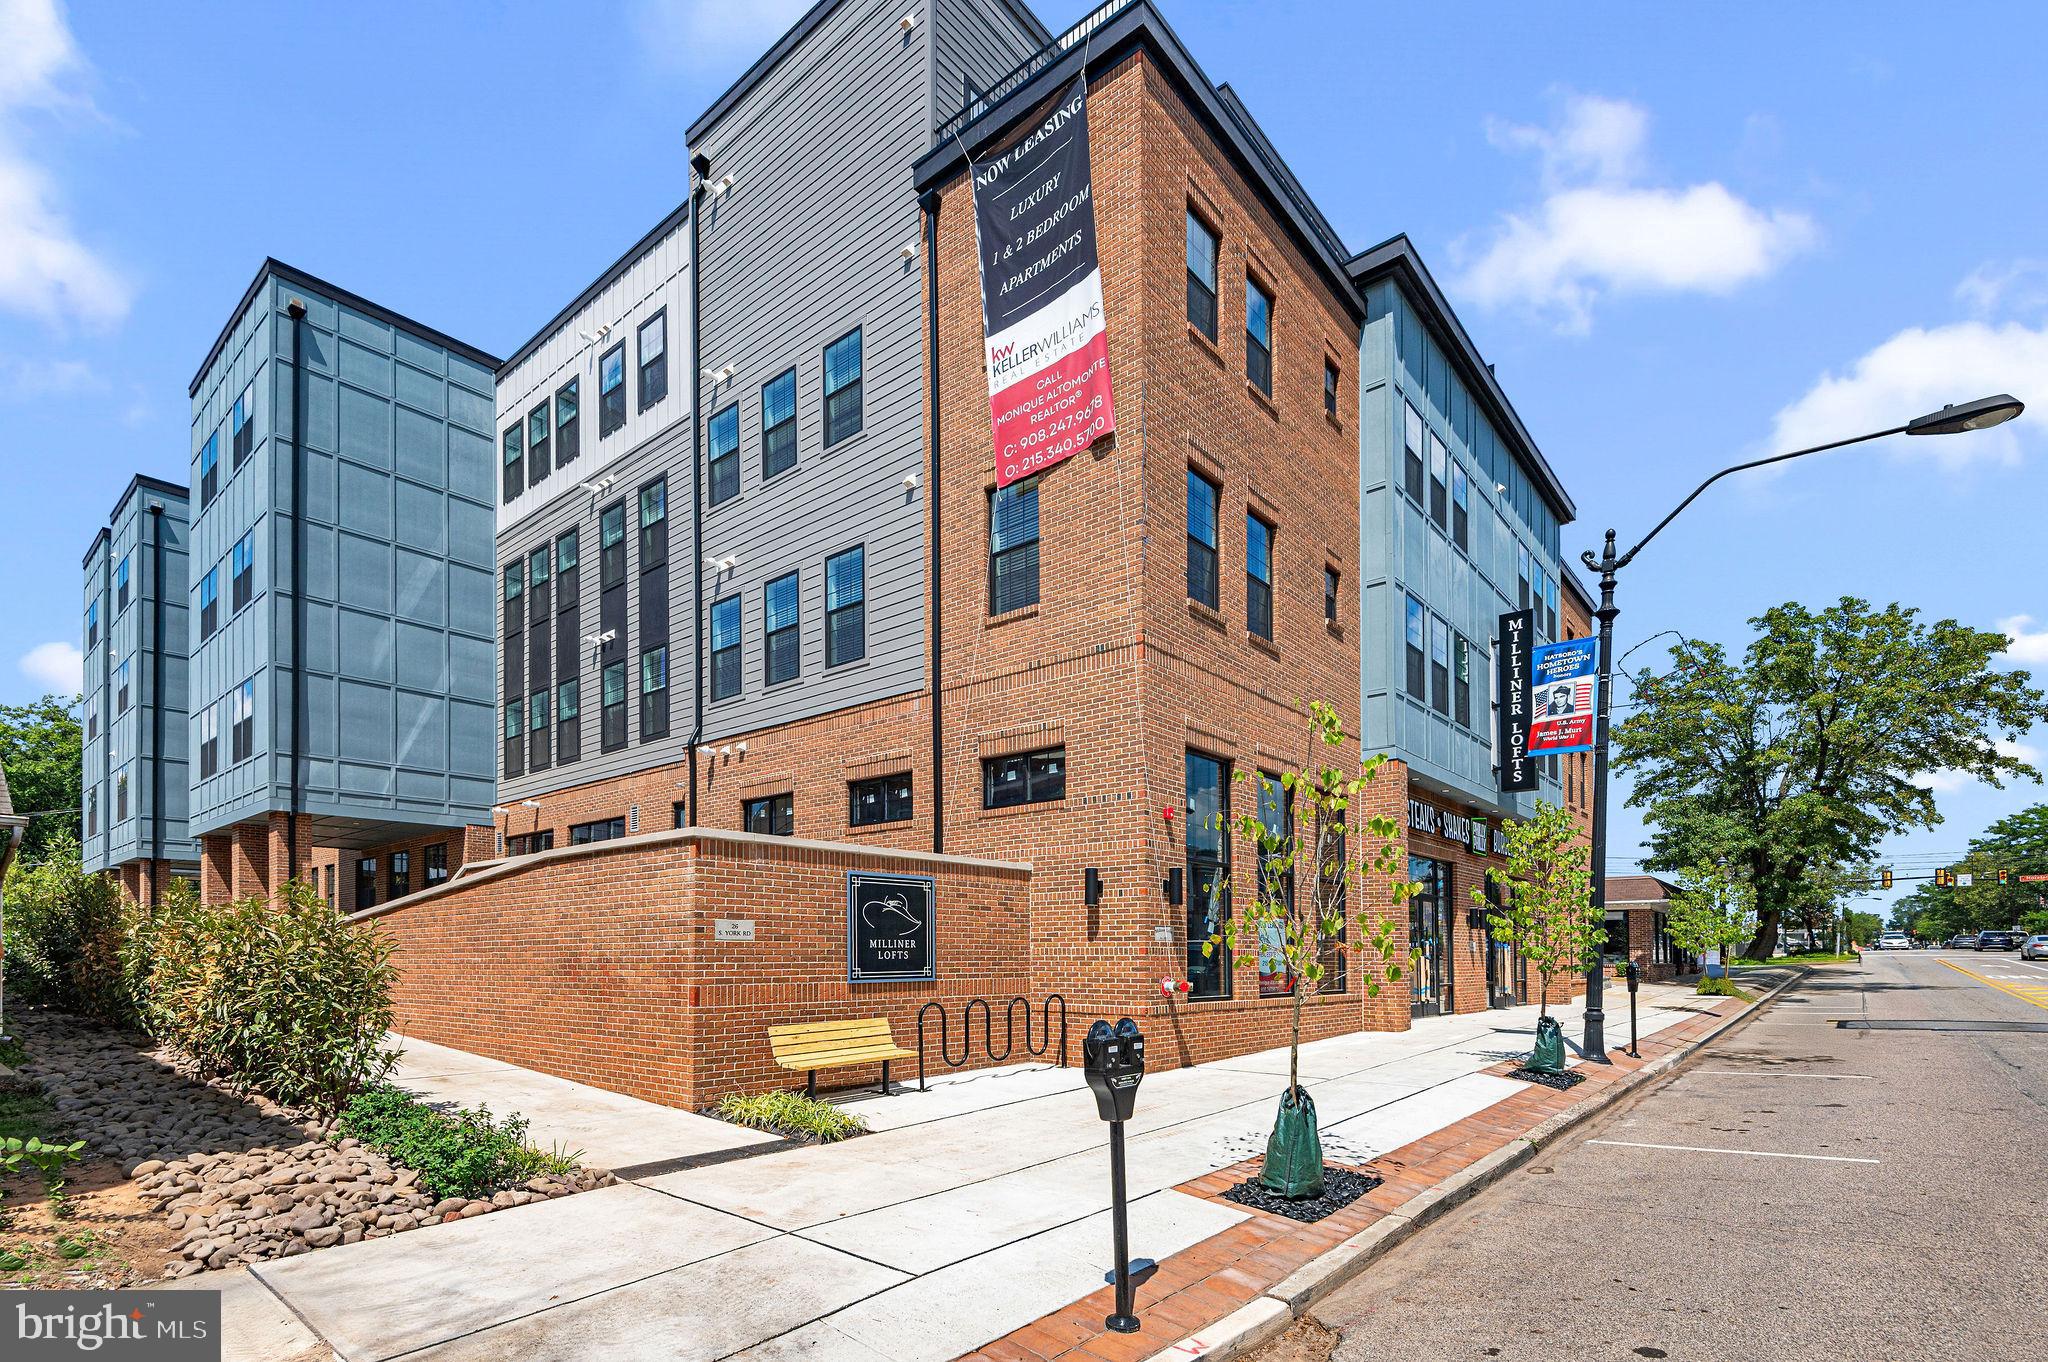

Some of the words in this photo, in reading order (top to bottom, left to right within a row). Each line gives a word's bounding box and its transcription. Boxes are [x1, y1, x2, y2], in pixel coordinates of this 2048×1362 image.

[976, 153, 1011, 191] NOW
[1014, 95, 1083, 162] LEASING
[1010, 172, 1061, 221] LUXURY
[993, 252, 999, 266] 1
[1003, 244, 1013, 259] &
[1016, 237, 1023, 251] 2
[1026, 184, 1090, 245] BEDROOM
[999, 229, 1082, 296] APARTMENTS
[994, 367, 1024, 389] REAL
[1035, 333, 1084, 367] ESTATE
[1036, 371, 1062, 390] CALL
[997, 394, 1045, 426] MONIQUE
[1046, 356, 1106, 402] ALTOMONTE
[1003, 444, 1017, 457] C:
[1508, 618, 1523, 715] MILLINER
[1536, 654, 1591, 670] HOMETOWN
[1547, 663, 1580, 675] HEROES
[1510, 722, 1524, 782] LOFTS
[1536, 730, 1557, 738] James
[1443, 811, 1470, 844] SHAKES
[869, 939, 916, 949] MILLINER
[878, 951, 909, 960] LOFTS
